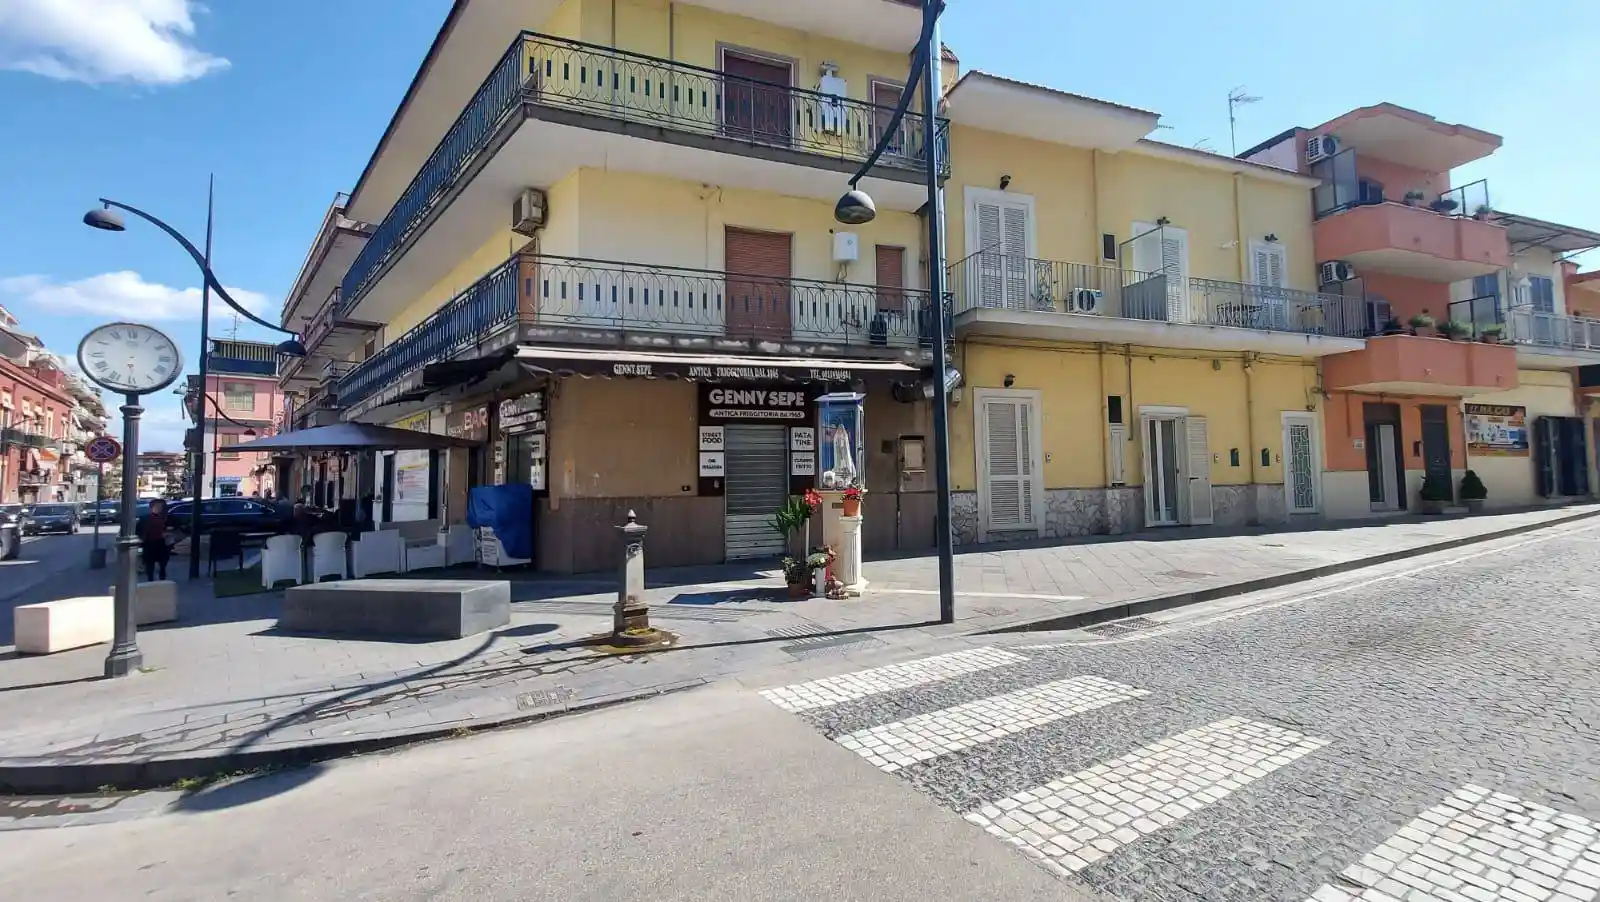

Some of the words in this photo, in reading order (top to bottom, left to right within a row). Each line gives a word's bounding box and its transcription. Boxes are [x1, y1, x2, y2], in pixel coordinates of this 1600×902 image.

[689, 366, 712, 377] ANTICA
[709, 389, 768, 406] GENNY
[768, 391, 805, 407] SEPE
[463, 406, 488, 431] BAR
[739, 410, 778, 418] FRIGGITORIA
[794, 432, 812, 440] PATA
